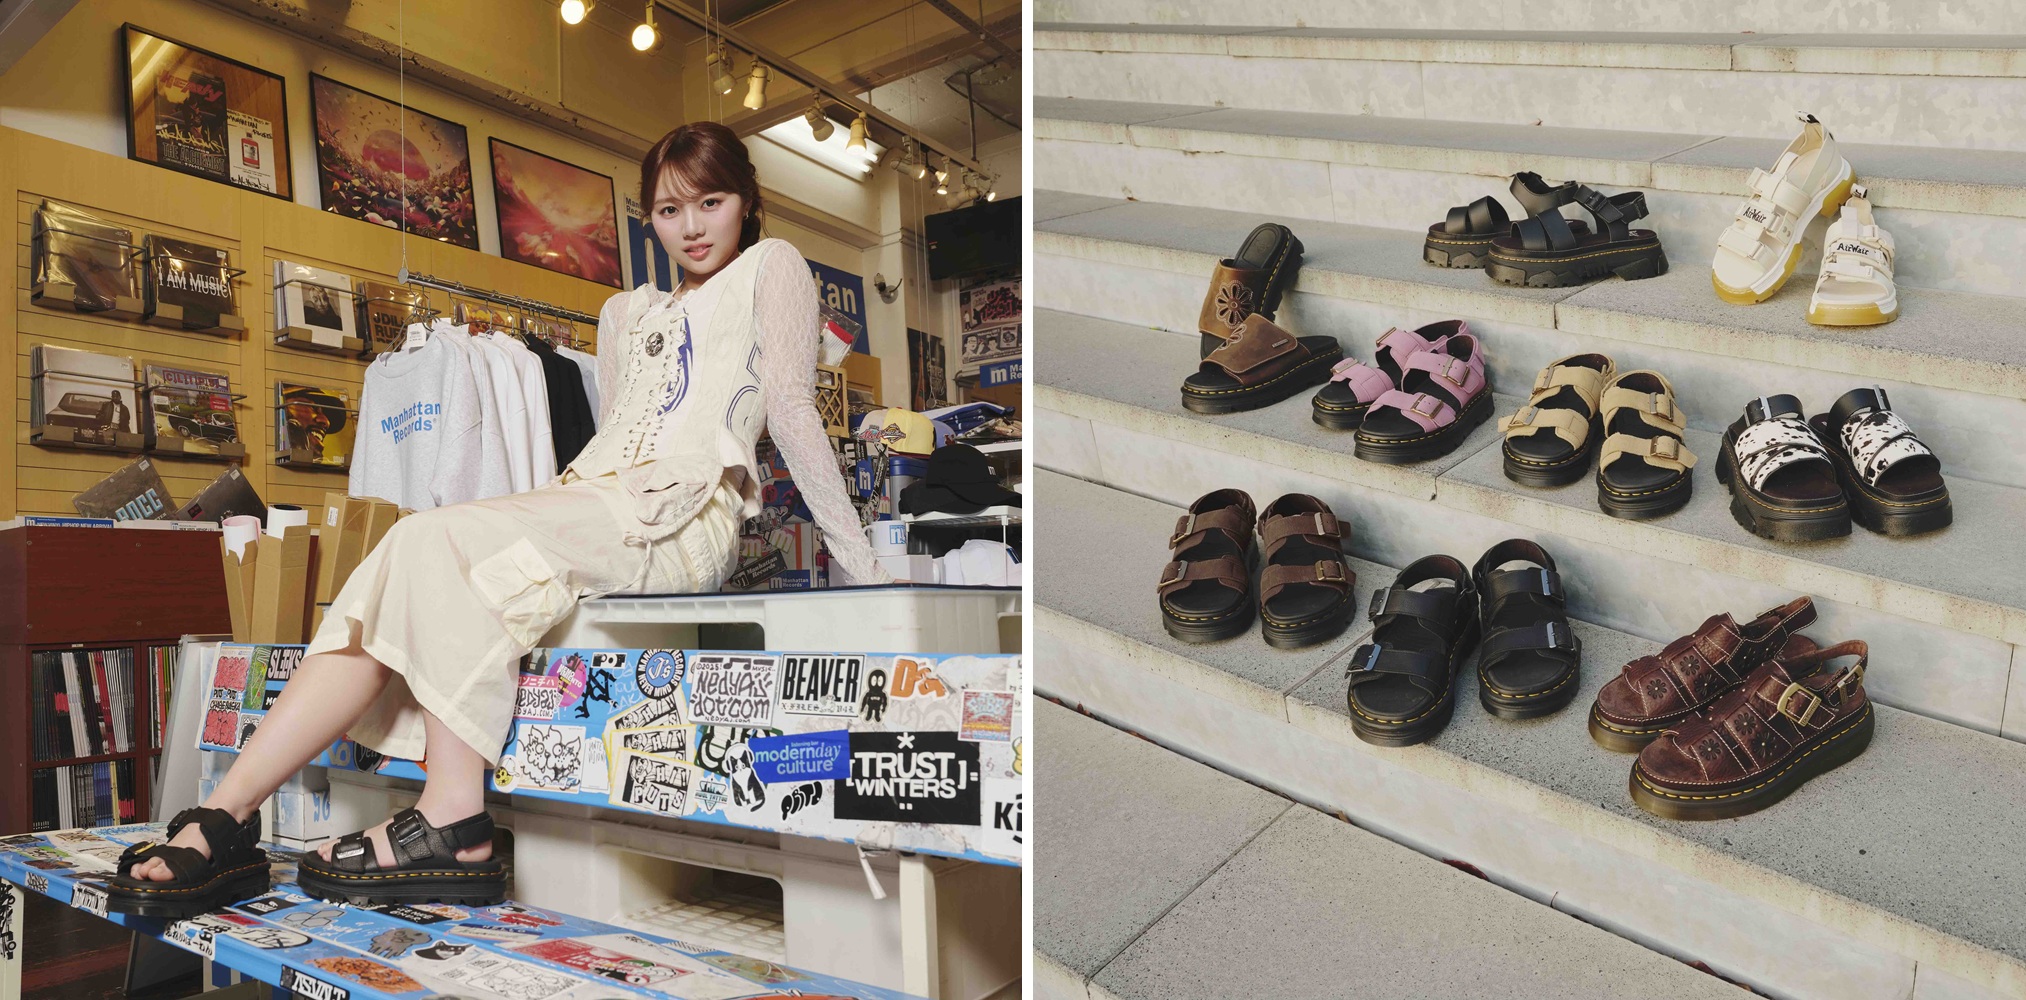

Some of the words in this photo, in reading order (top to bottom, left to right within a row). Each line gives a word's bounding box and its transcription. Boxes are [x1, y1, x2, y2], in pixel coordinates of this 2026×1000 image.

[1837, 243, 1869, 255] AirWair
[380, 401, 441, 433] Manhattan
[393, 417, 433, 444] Records
[782, 658, 860, 702] BEAVER
[777, 759, 833, 775] culture
[854, 752, 955, 779] TRUST
[634, 784, 685, 811] PUTS
[854, 778, 956, 799] WINTERS
